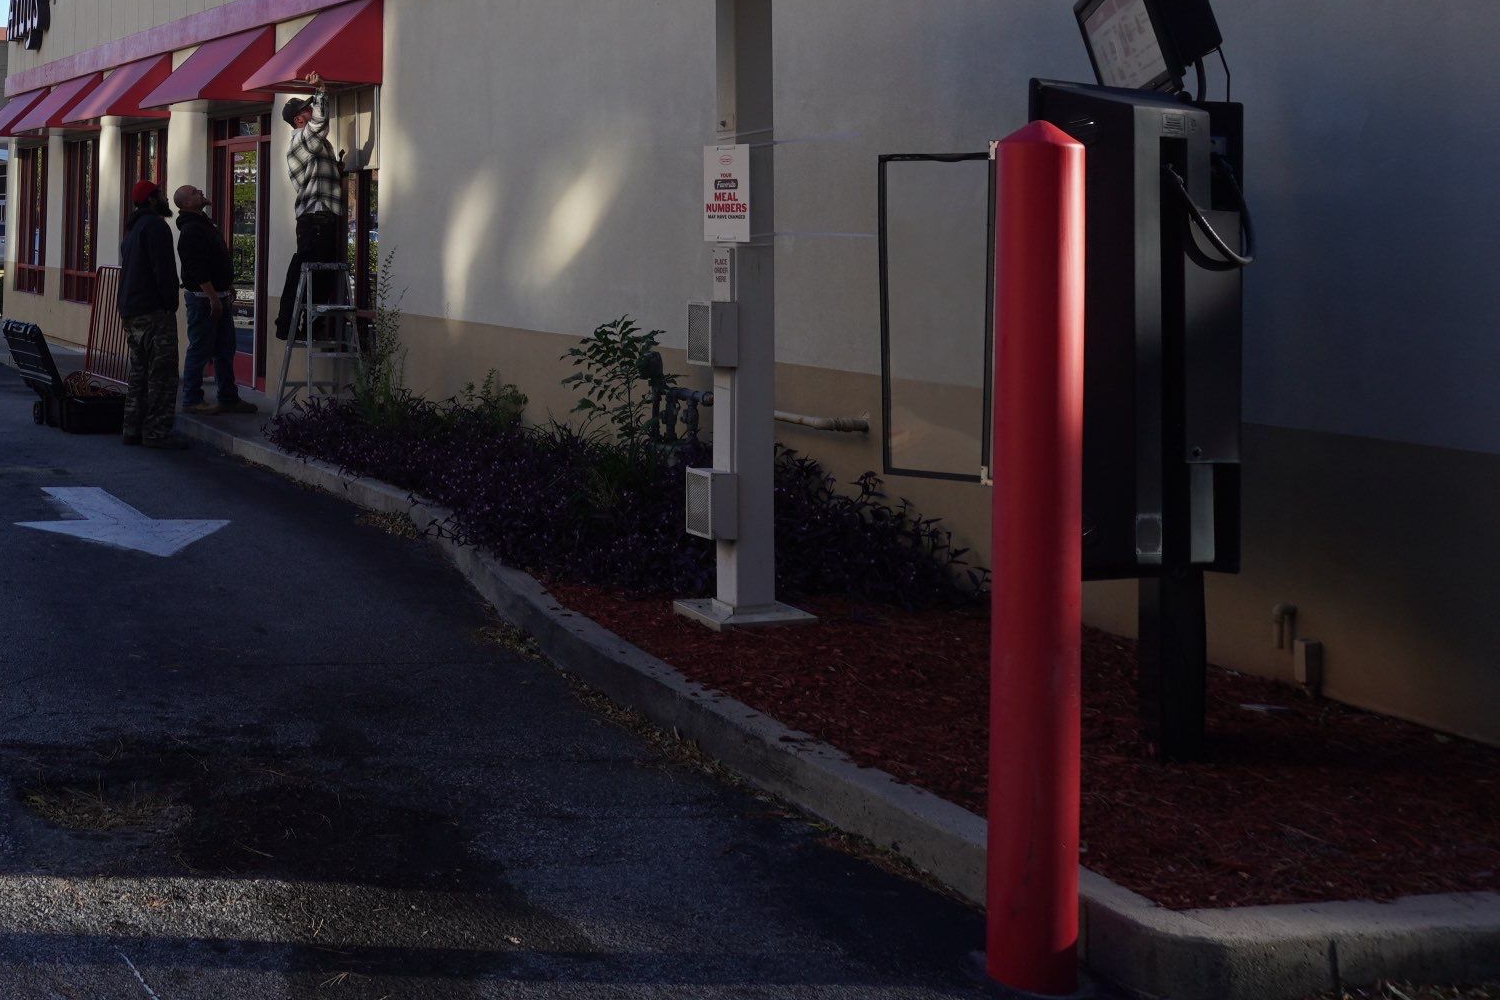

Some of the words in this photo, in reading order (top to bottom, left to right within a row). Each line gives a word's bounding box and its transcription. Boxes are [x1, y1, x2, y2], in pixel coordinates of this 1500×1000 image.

[714, 192, 738, 201] MEAL
[706, 203, 747, 213] NUMBERS
[715, 275, 727, 283] HERE
